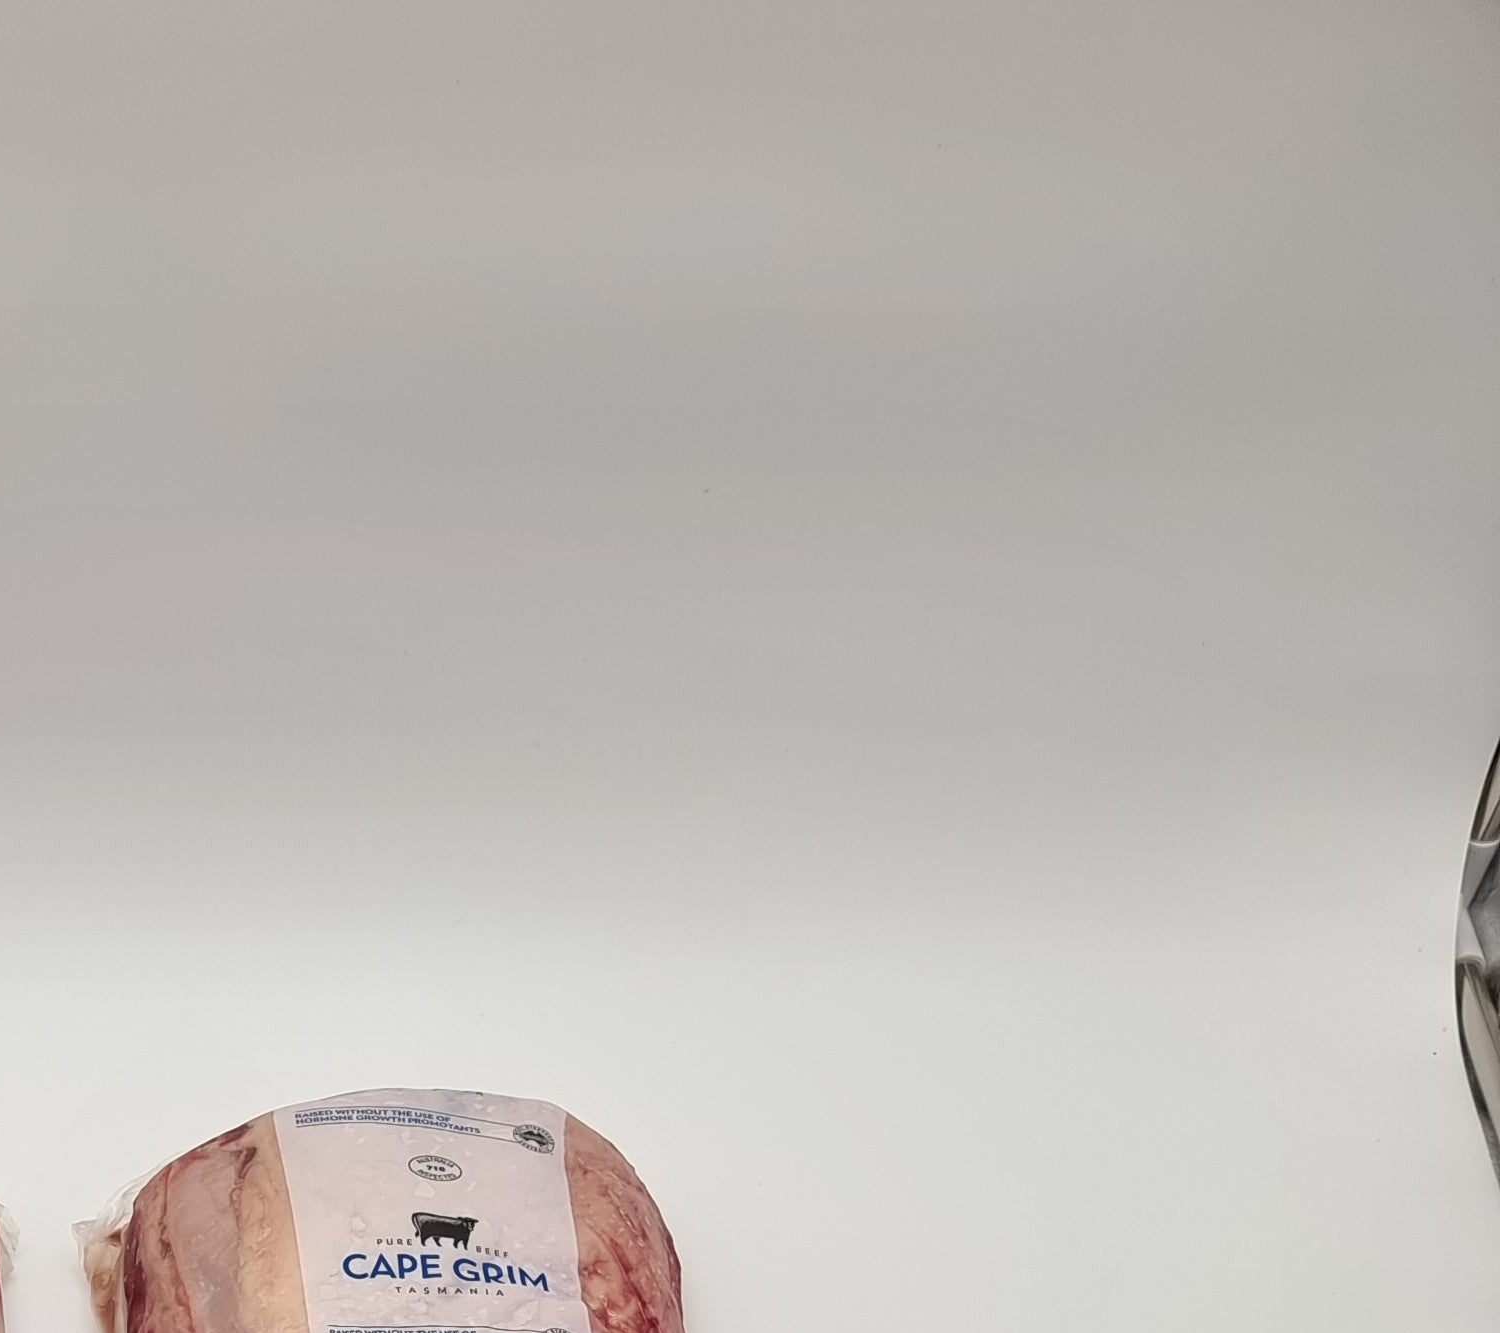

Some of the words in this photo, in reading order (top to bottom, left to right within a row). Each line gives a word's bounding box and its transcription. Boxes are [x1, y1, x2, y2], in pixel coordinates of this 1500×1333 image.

[295, 1110, 332, 1119] RAISED
[414, 1111, 433, 1119] USE
[295, 1115, 353, 1124] HORMONE
[356, 1114, 406, 1123] GROWTH
[408, 1117, 481, 1133] PROMOTANTS
[376, 1238, 412, 1246] PURE
[476, 1246, 509, 1258] BEEF
[343, 1253, 442, 1279] CAPE
[453, 1259, 550, 1292] GRIM
[394, 1286, 504, 1297] TASMANIA
